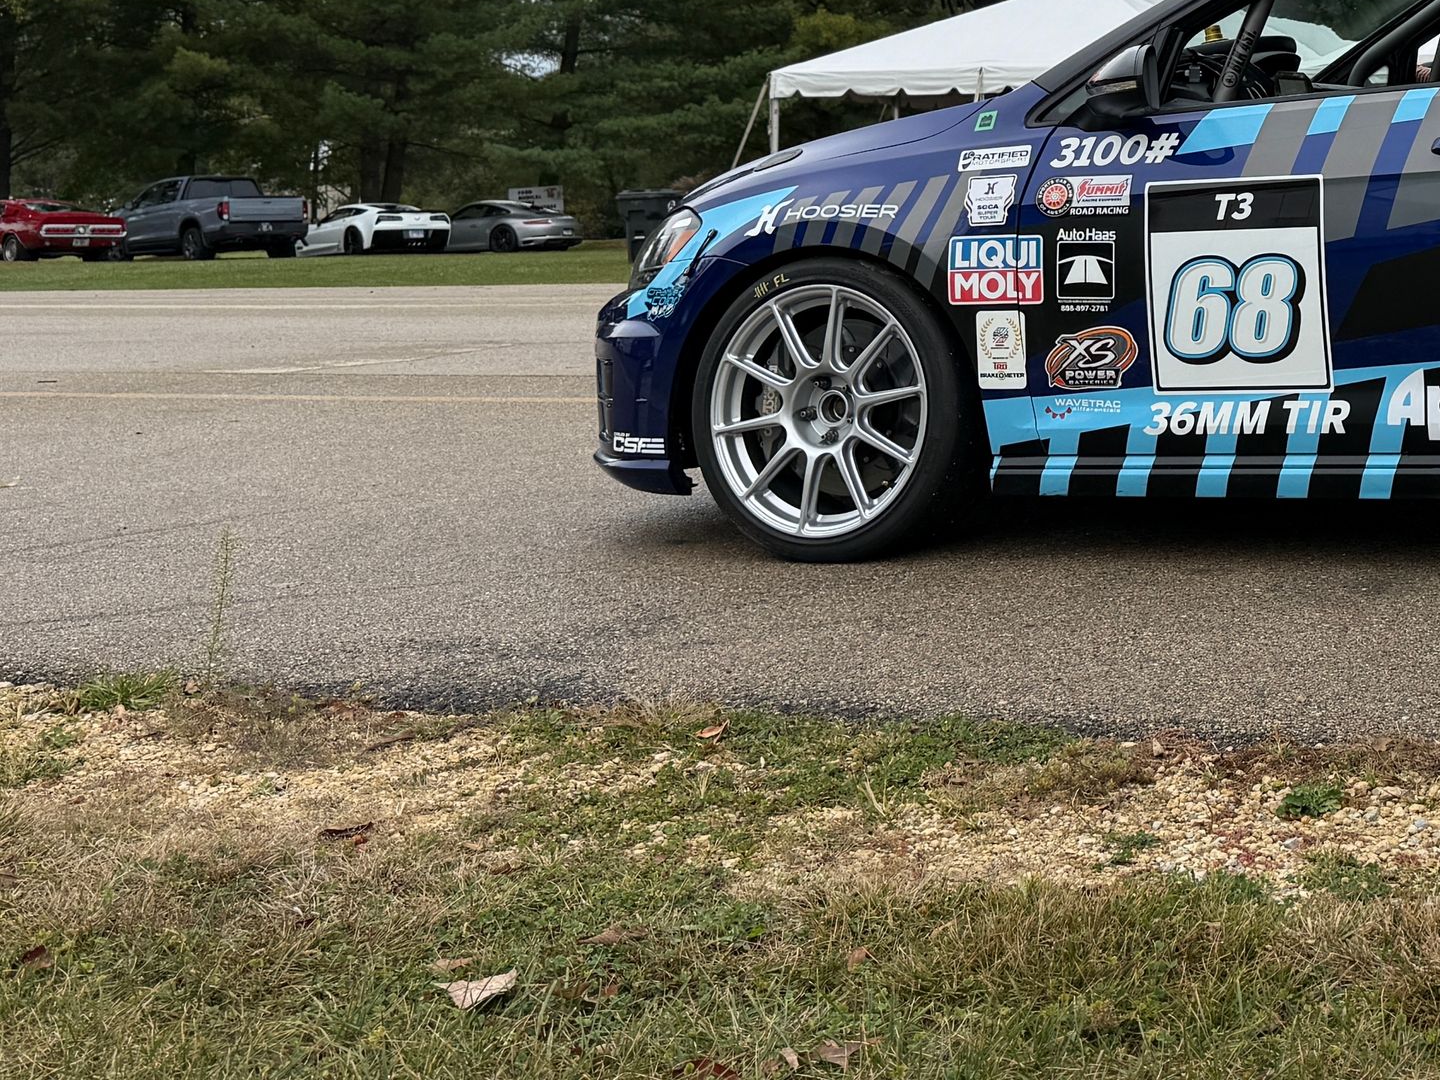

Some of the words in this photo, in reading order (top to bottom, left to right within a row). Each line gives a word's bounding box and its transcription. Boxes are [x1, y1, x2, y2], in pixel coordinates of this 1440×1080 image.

[1050, 132, 1180, 169] 3100#
[783, 204, 899, 221] HOOSIER
[1069, 207, 1095, 216] ROAD
[1096, 206, 1129, 215] RACING
[1214, 192, 1254, 221] T3
[955, 240, 1037, 269] LIQUI
[954, 271, 1040, 300] MOLY
[1163, 252, 1307, 365] 68
[1054, 338, 1116, 376] XS
[1065, 370, 1117, 380] POWER
[1055, 398, 1121, 407] WAVETRAC
[1143, 400, 1271, 436] 36MM
[1282, 400, 1351, 434] TIR
